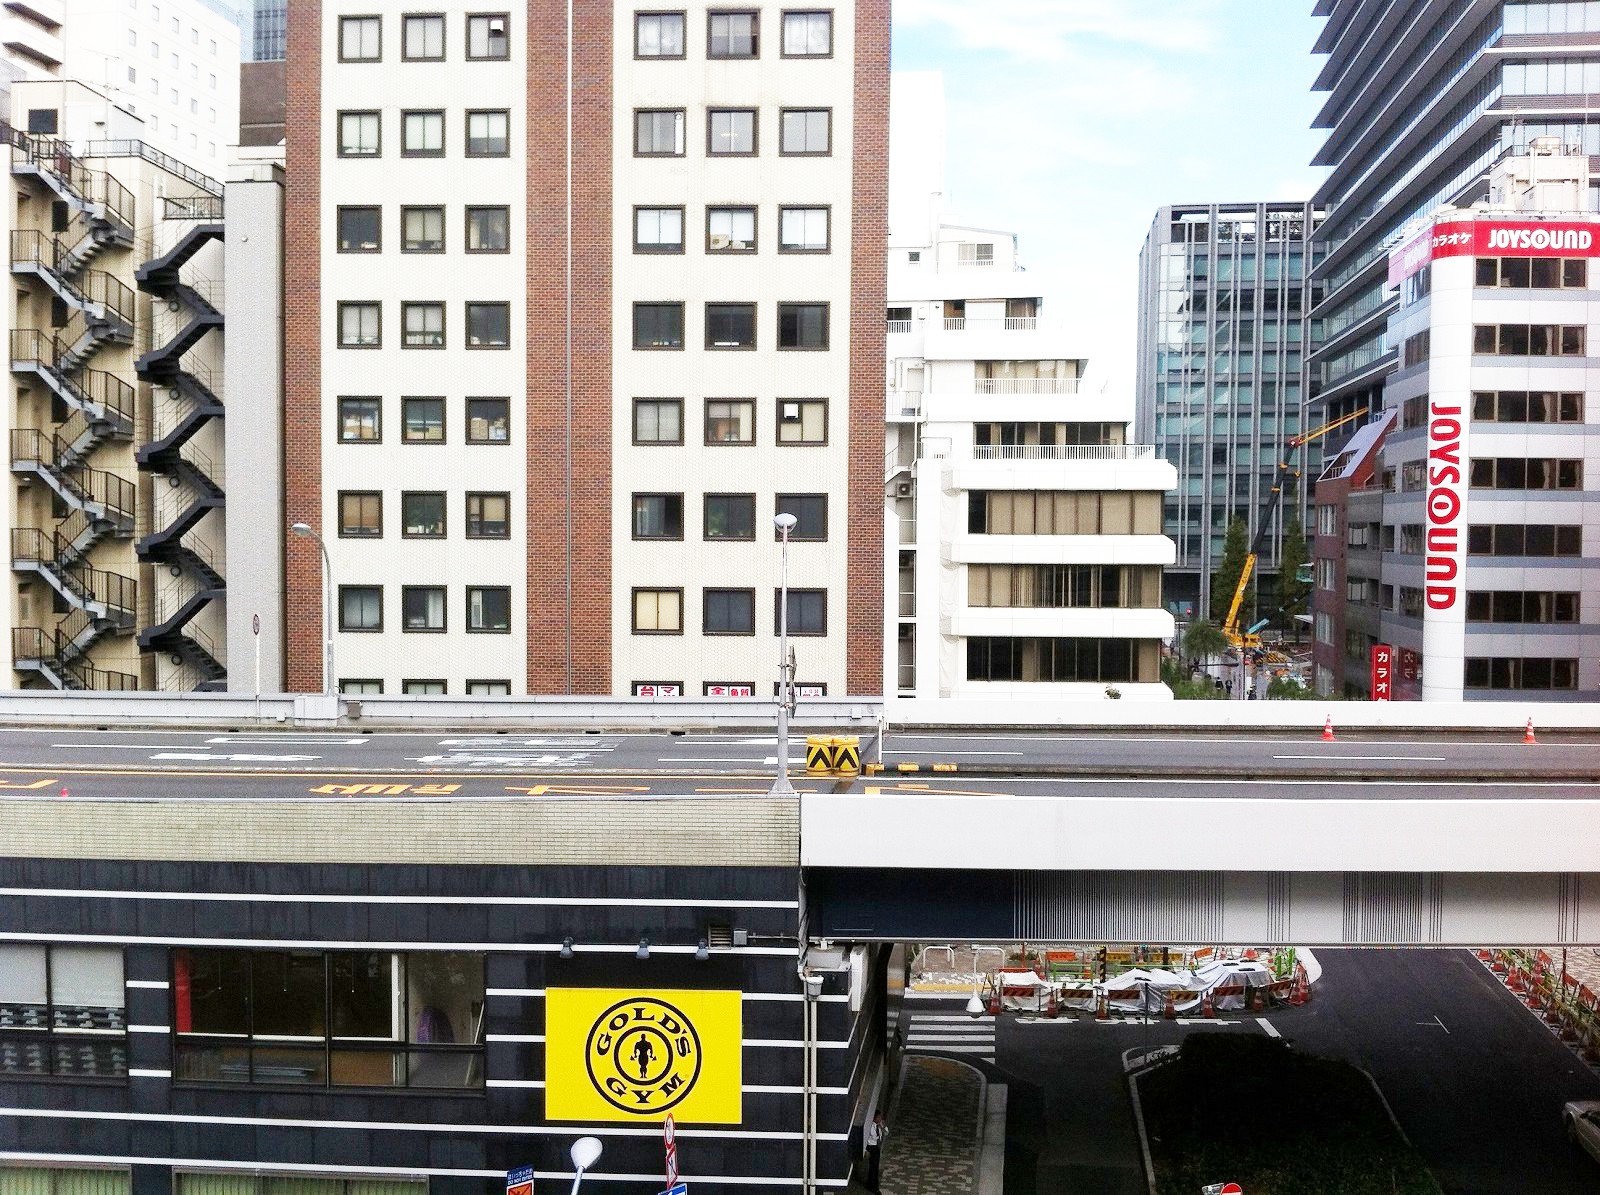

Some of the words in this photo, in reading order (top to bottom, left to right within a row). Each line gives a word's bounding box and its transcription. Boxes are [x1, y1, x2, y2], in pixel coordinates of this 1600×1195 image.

[1432, 232, 1472, 248] カラオケ
[1488, 228, 1592, 250] JOYSOUND
[1427, 401, 1461, 610] JOYSOUND
[596, 1007, 692, 1058] GOLD'S
[605, 1071, 686, 1104] GYM
